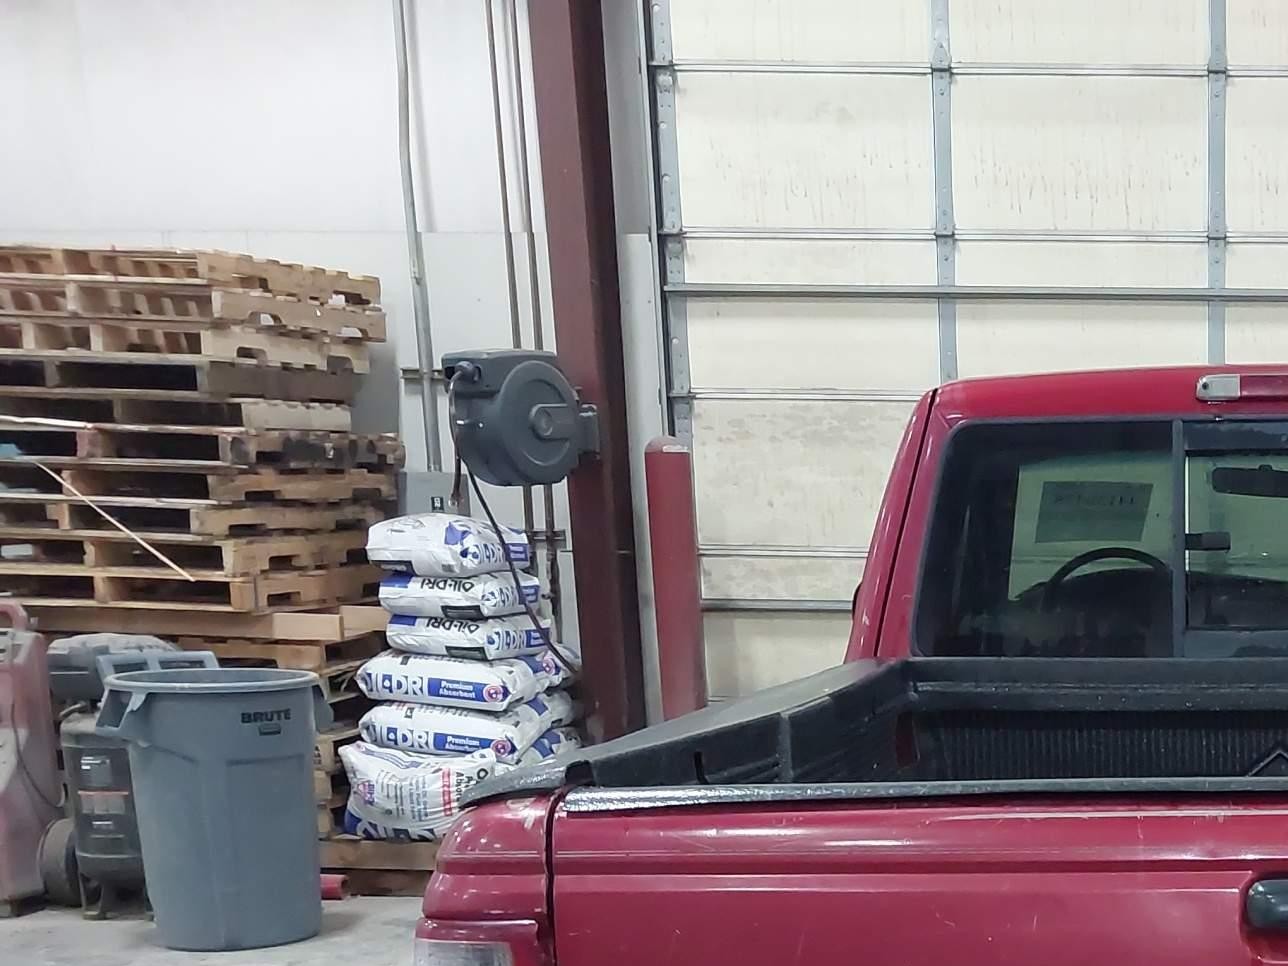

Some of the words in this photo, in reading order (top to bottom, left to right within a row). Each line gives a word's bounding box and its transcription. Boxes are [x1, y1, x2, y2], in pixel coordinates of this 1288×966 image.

[441, 680, 474, 691] Premium
[439, 688, 476, 699] Absorbent
[241, 707, 291, 724] BRUTE
[446, 735, 480, 747] Premium
